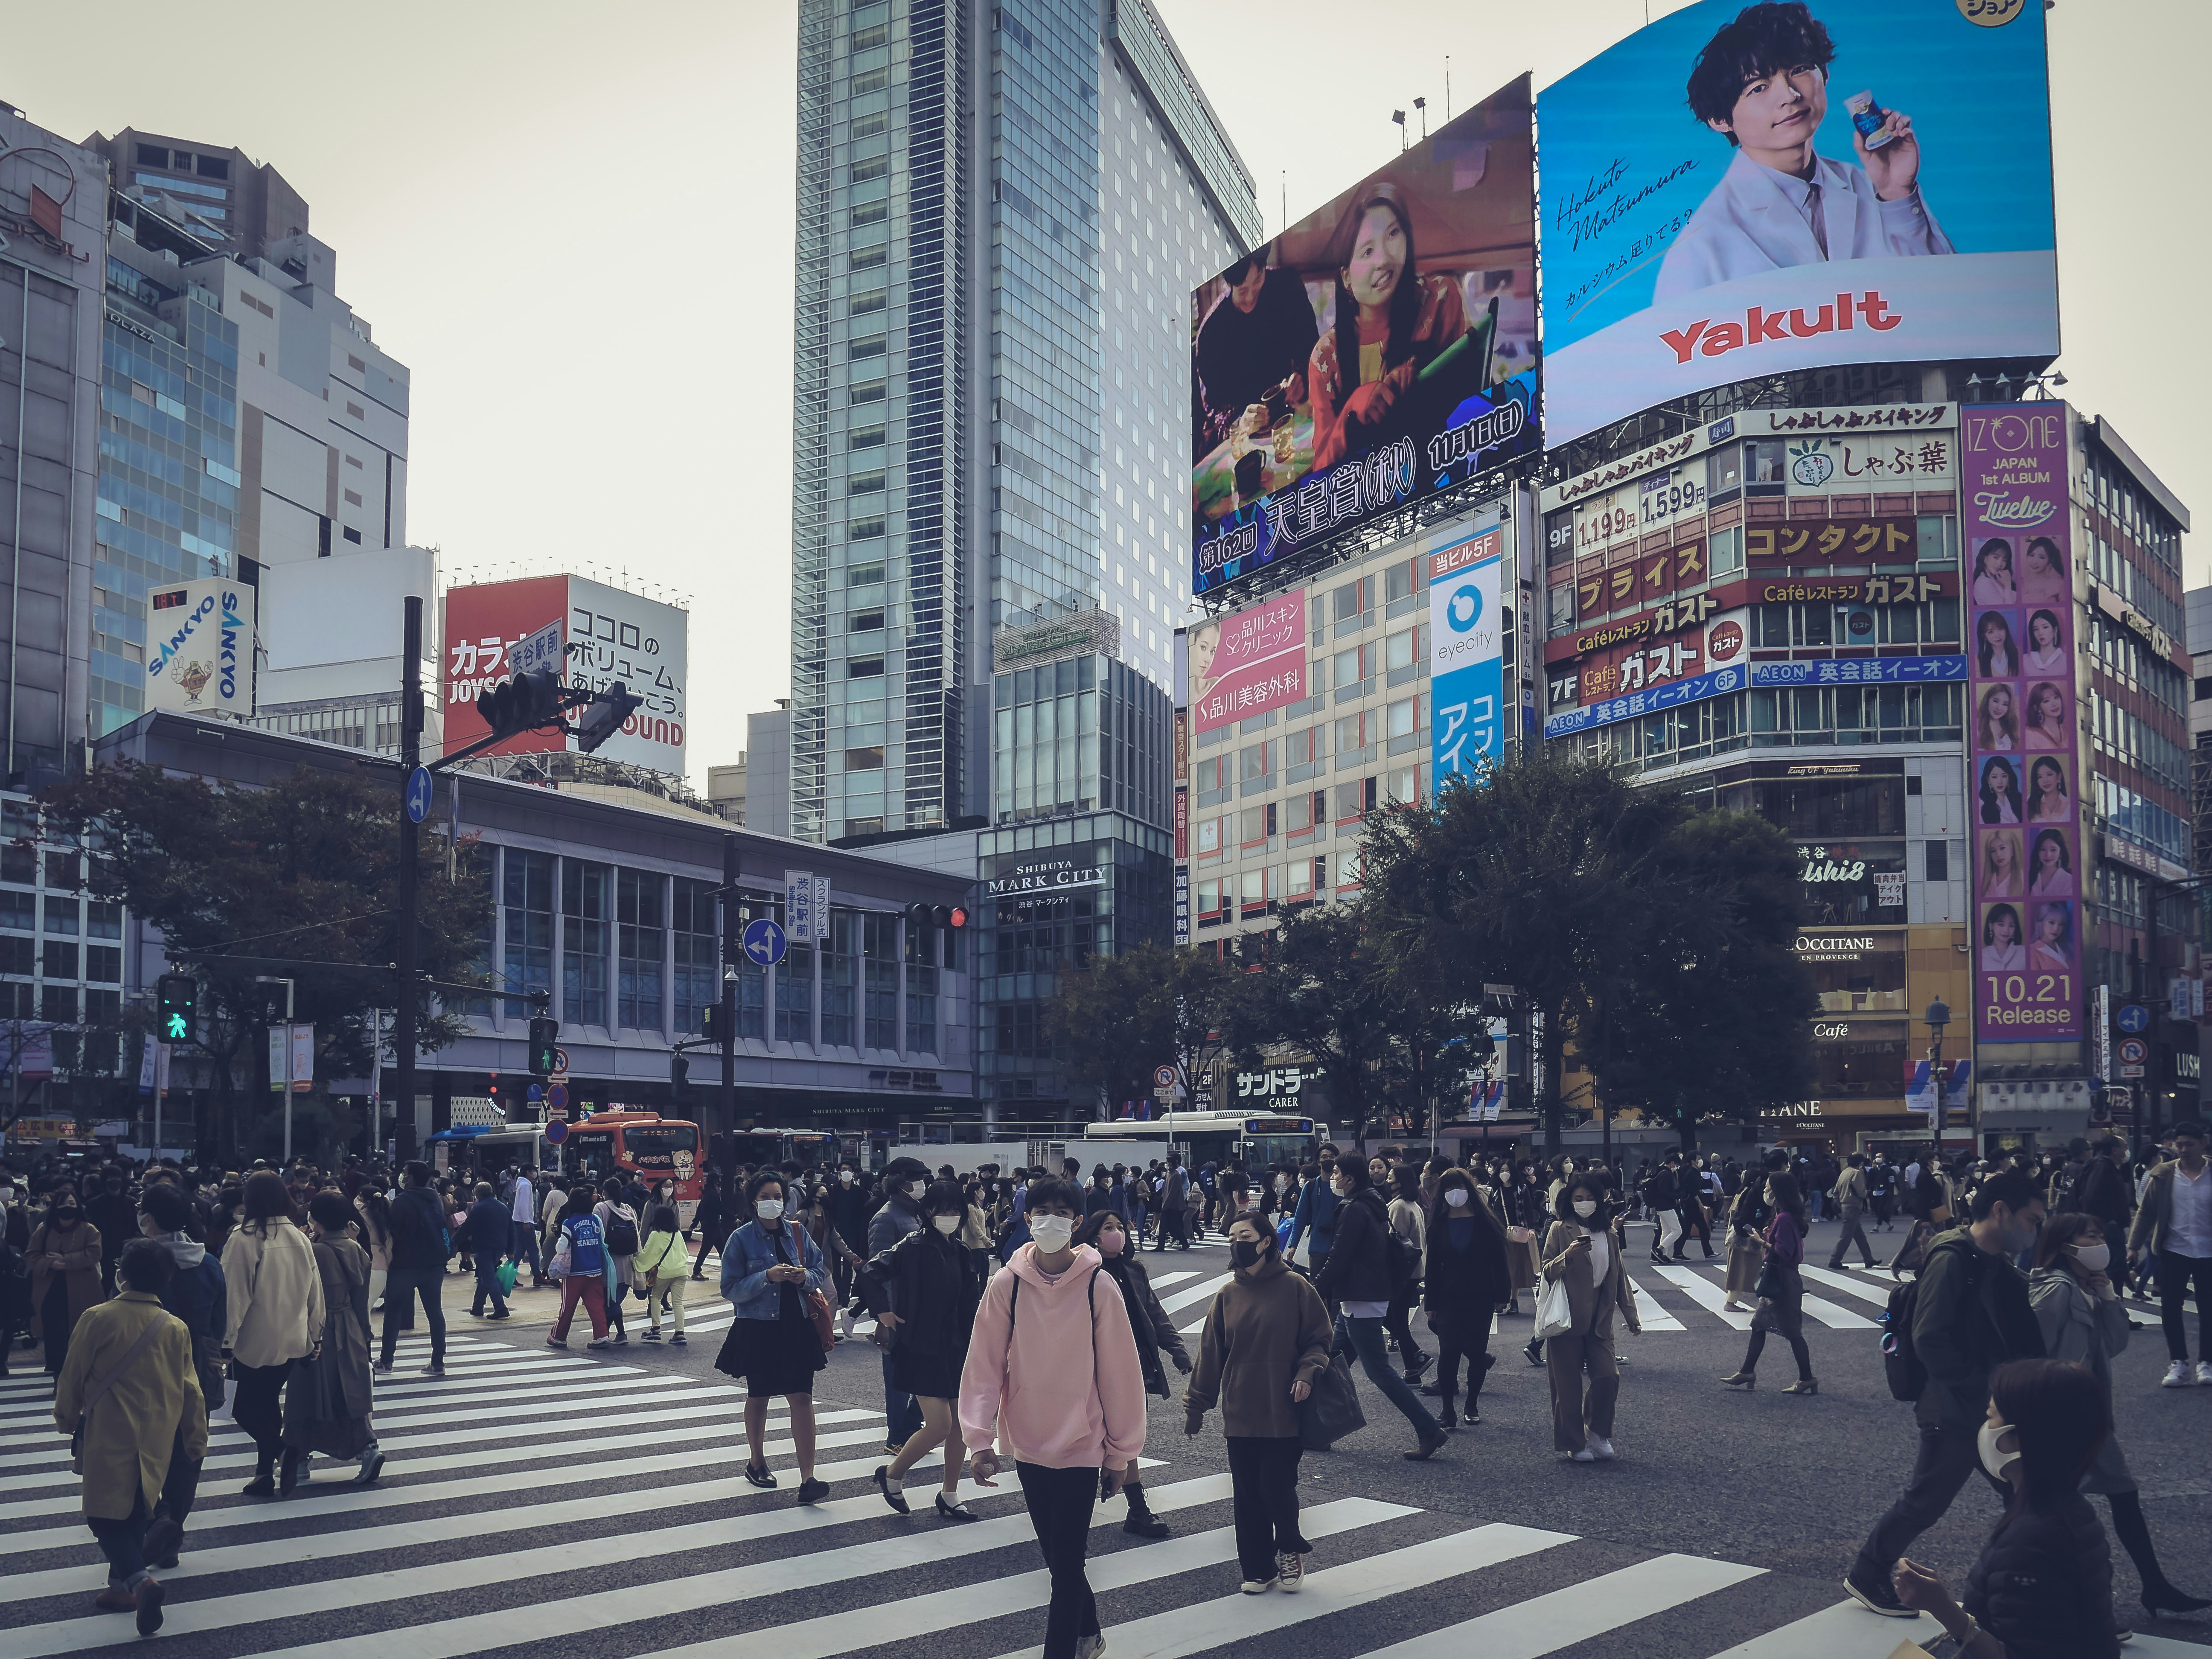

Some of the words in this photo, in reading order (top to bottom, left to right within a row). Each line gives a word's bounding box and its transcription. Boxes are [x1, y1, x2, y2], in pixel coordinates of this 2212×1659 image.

[1557, 157, 1630, 230] Hokuto
[1567, 160, 1700, 252] Matsumura
[111, 314, 155, 343] PLAZA
[1659, 291, 1902, 364] Yakult
[1711, 420, 1731, 439] 寿司
[1770, 406, 1947, 430] しゃぶしゃぶバイキング
[1559, 433, 1695, 501] しゃぶしゃぶバイキング
[1844, 440, 1947, 477] しゃぶ葉
[1993, 457, 2037, 470] JAPAN
[1644, 477, 1668, 492] ディナー
[1981, 474, 1998, 485] 1st
[2001, 472, 2050, 484] ALBUM
[1264, 437, 1416, 556] 天皇賞(秋)
[1642, 481, 1706, 525] 1,599円
[1974, 492, 2057, 528] Twelve
[1550, 525, 1572, 548] 9F
[1578, 508, 1637, 548] 1,199円
[1748, 524, 1909, 555] コンタクト
[1200, 522, 1257, 574] 第162回
[1436, 536, 1493, 573] 当ビル5F
[1580, 545, 1703, 611] プライス
[1764, 584, 1858, 601] Caféレストラン
[1865, 575, 1941, 604] ガスト
[573, 606, 659, 655] ココロの
[1241, 604, 1299, 639] 品川スキン
[1576, 619, 1649, 653] Caféレストラン
[1655, 594, 1717, 635] ガスト
[149, 596, 215, 677] SANKYO
[220, 591, 245, 699] SANKYO
[1242, 625, 1292, 658] クリニック
[1439, 631, 1493, 661] eyecity
[1522, 611, 1531, 669] 献血ルーム
[1713, 637, 1740, 653] ガスト
[513, 629, 558, 674] 渋谷駅前
[1584, 664, 1616, 687] Café
[1620, 642, 1697, 693] ガスト
[1760, 665, 1805, 681] AEON
[1210, 668, 1300, 720] 品川美容外科
[1550, 711, 1585, 732] AEON
[1717, 673, 1735, 689] 6F
[1551, 675, 1577, 702] 7F
[1585, 681, 1615, 697] レストラン
[1177, 794, 1186, 829] 外貨両替
[1797, 846, 1827, 859] 渋谷
[989, 876, 1047, 893] MARK
[1057, 867, 1106, 884] CITY
[1017, 860, 1072, 875] SHIBUYA
[1874, 873, 1905, 884] 焼肉弁当
[1019, 900, 1033, 908] 渋谷
[1035, 896, 1069, 907] マークシティ
[1879, 885, 1902, 894] テイク
[1879, 895, 1902, 904] アウト
[797, 877, 809, 937] 渋谷駅前
[816, 879, 826, 936] スクランブル式
[1176, 876, 1187, 932] 加藤眼科
[1177, 936, 1187, 944] 5F
[1988, 975, 2069, 1003] 10.21
[1987, 1005, 2070, 1025] Release
[1814, 1024, 1848, 1040] Café
[2177, 1053, 2200, 1078] LUSH
[1202, 1075, 1212, 1085] 2F
[1195, 1092, 1212, 1102] 方せん
[1196, 1103, 1207, 1112] 受付
[1269, 1097, 1298, 1108] CARER
[638, 1155, 670, 1164] ハチ公バス
[574, 1220, 591, 1231] SCHOOL
[442, 1228, 451, 1254] adidas
[577, 1238, 599, 1247] SCARING
